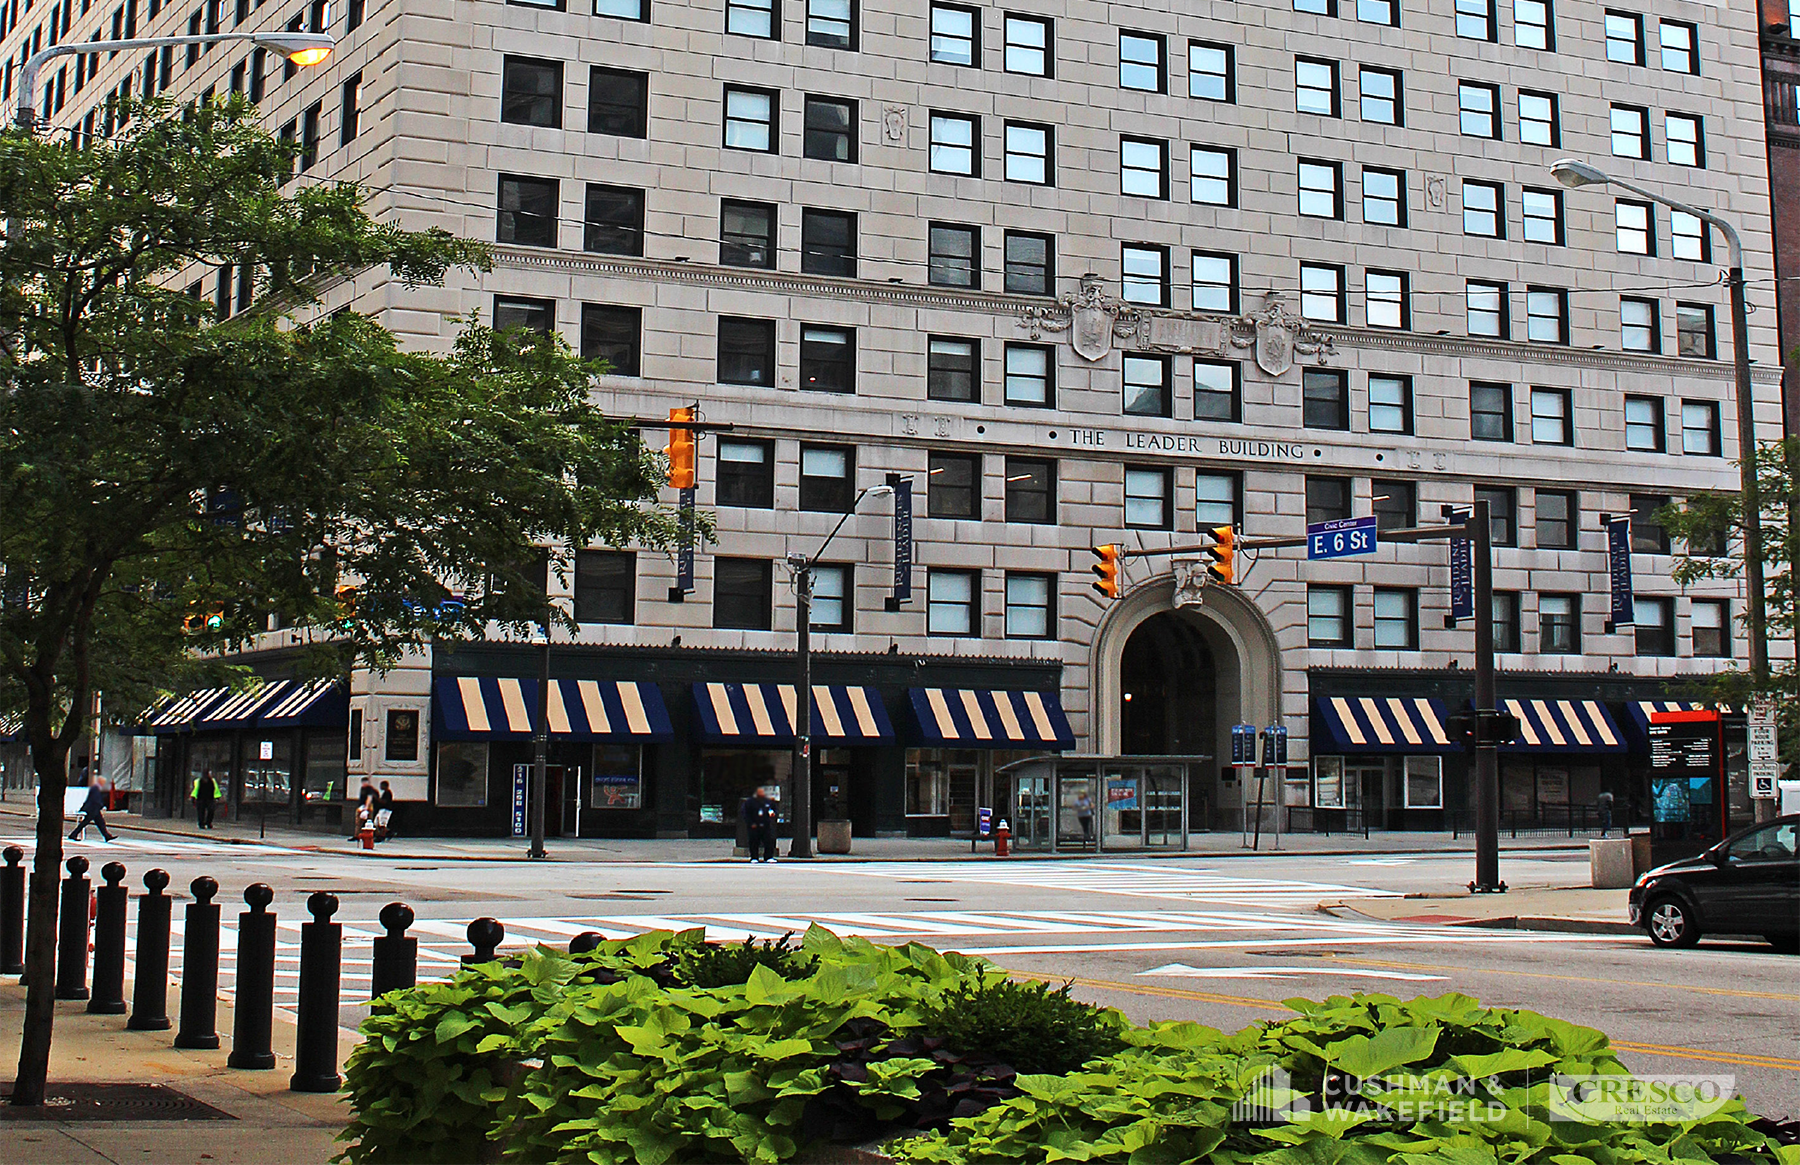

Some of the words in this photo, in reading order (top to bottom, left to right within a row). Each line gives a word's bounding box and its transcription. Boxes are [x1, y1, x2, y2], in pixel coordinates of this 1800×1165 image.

[1069, 429, 1105, 446] THE
[1126, 433, 1202, 452] LEADER
[1219, 440, 1304, 459] BUILDING
[1314, 535, 1328, 554] E.
[1333, 532, 1344, 552] 6
[1350, 530, 1368, 549] St
[1324, 522, 1338, 530] Civic
[1338, 520, 1357, 528] Center
[1451, 538, 1464, 606] RESIDENC
[1612, 532, 1623, 611] RESIDENCES
[1619, 546, 1629, 591] LEADER
